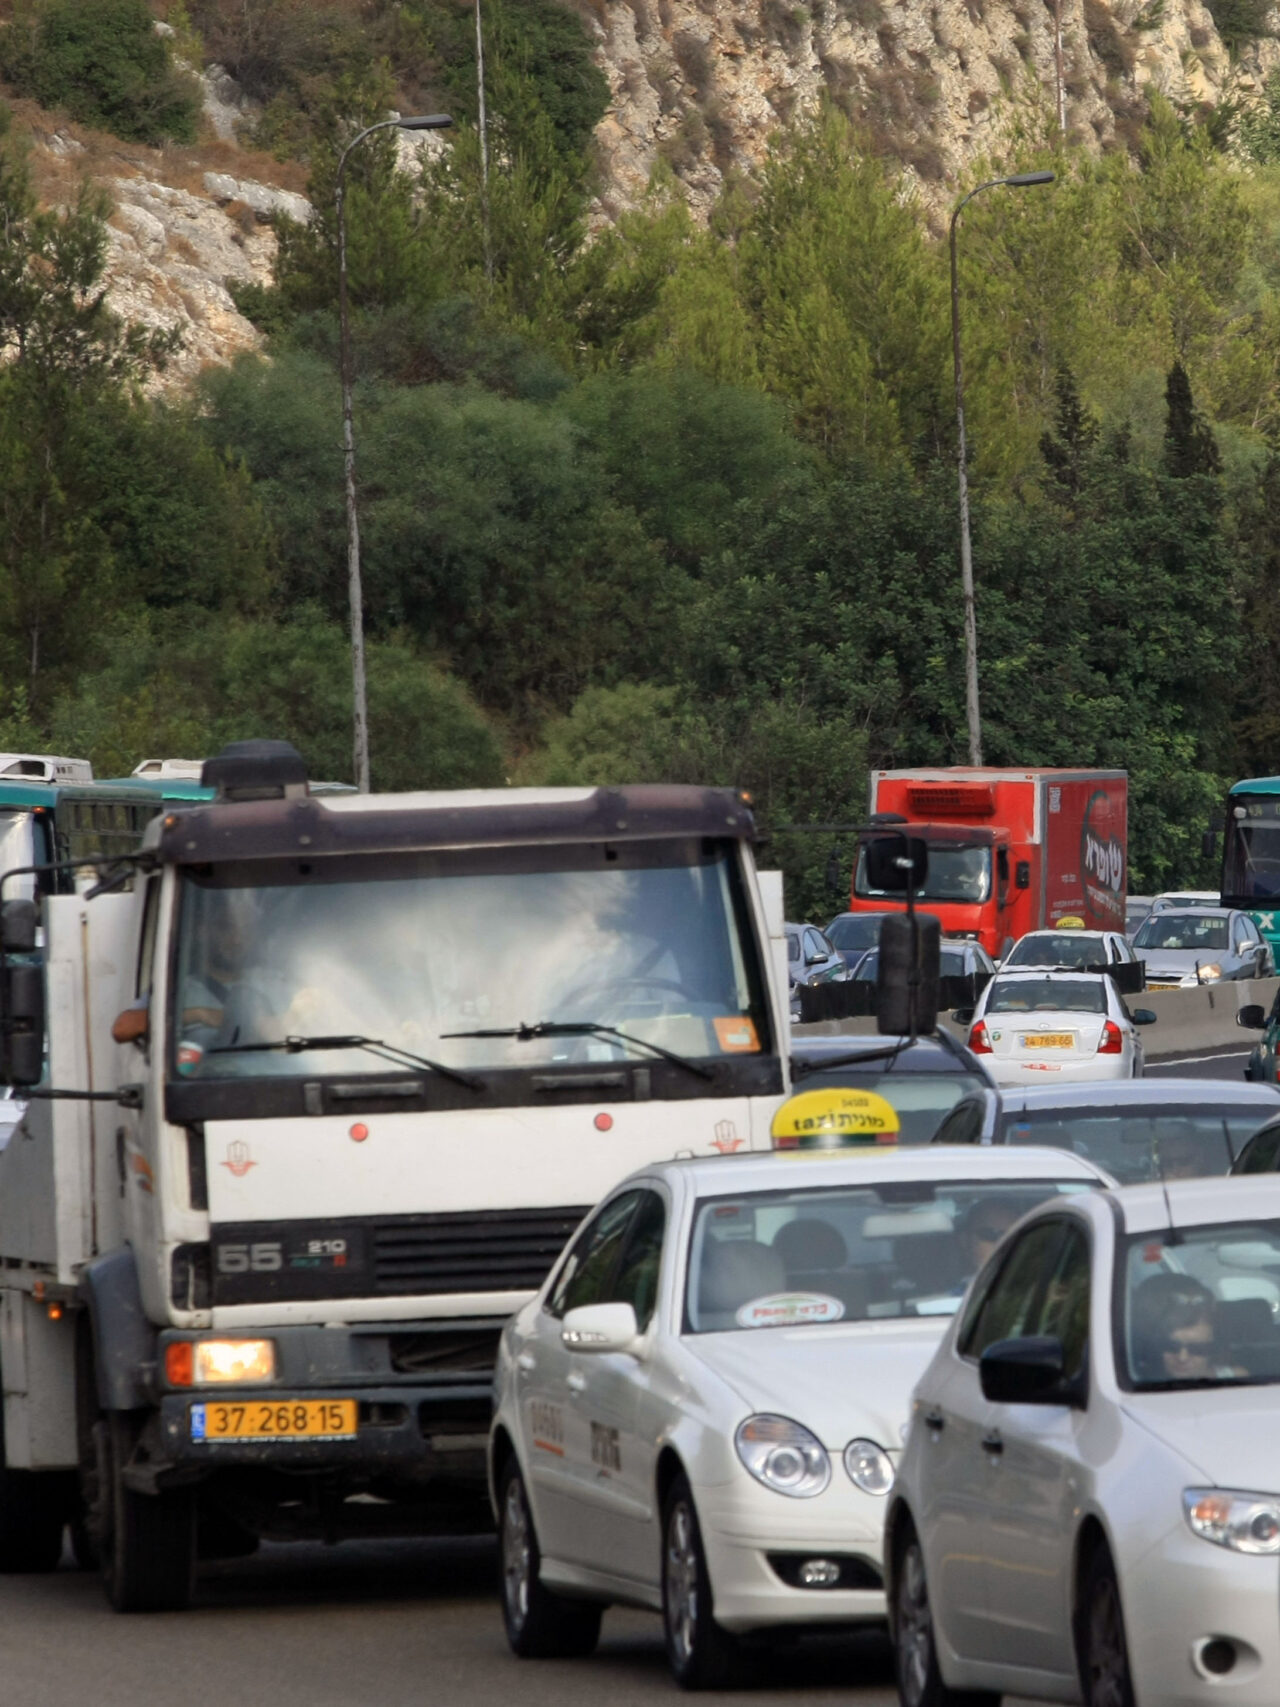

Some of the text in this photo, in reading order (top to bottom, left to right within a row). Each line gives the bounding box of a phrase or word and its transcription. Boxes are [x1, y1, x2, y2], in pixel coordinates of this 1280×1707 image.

[793, 1109, 885, 1131] taxi מונית
[308, 1240, 346, 1254] 210
